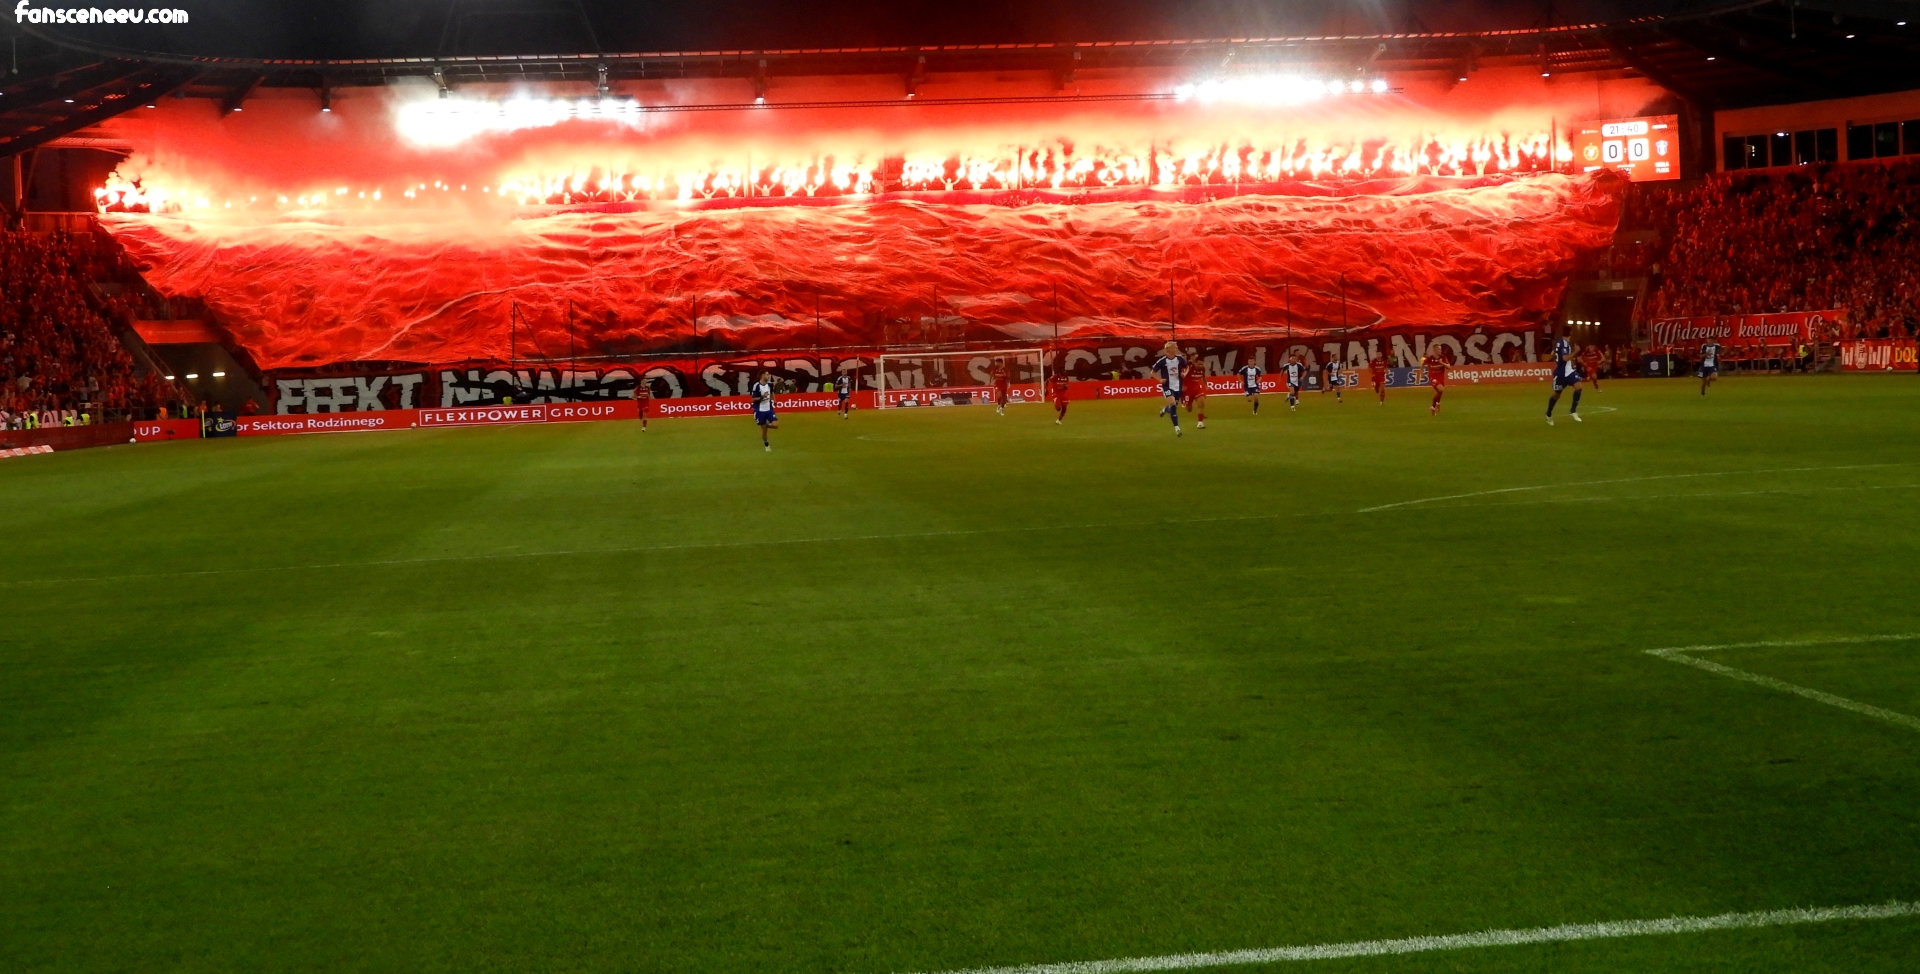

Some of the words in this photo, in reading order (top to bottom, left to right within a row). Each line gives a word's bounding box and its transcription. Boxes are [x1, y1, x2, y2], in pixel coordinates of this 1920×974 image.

[1608, 144, 1618, 159] 0
[1634, 142, 1643, 157] 0
[1654, 320, 1732, 345] Widzewie
[1447, 366, 1553, 382] sklep.widzew.com
[1103, 385, 1152, 396] Sponsor
[1207, 379, 1276, 391] Rodziego
[425, 409, 541, 422] FLEXIPOWER
[551, 406, 615, 417] GROUP
[660, 403, 711, 414] Sponsor
[715, 401, 753, 411] Sekto
[134, 426, 161, 436] UP
[252, 420, 303, 431] Sektora
[308, 417, 384, 428] Rodzinnego
